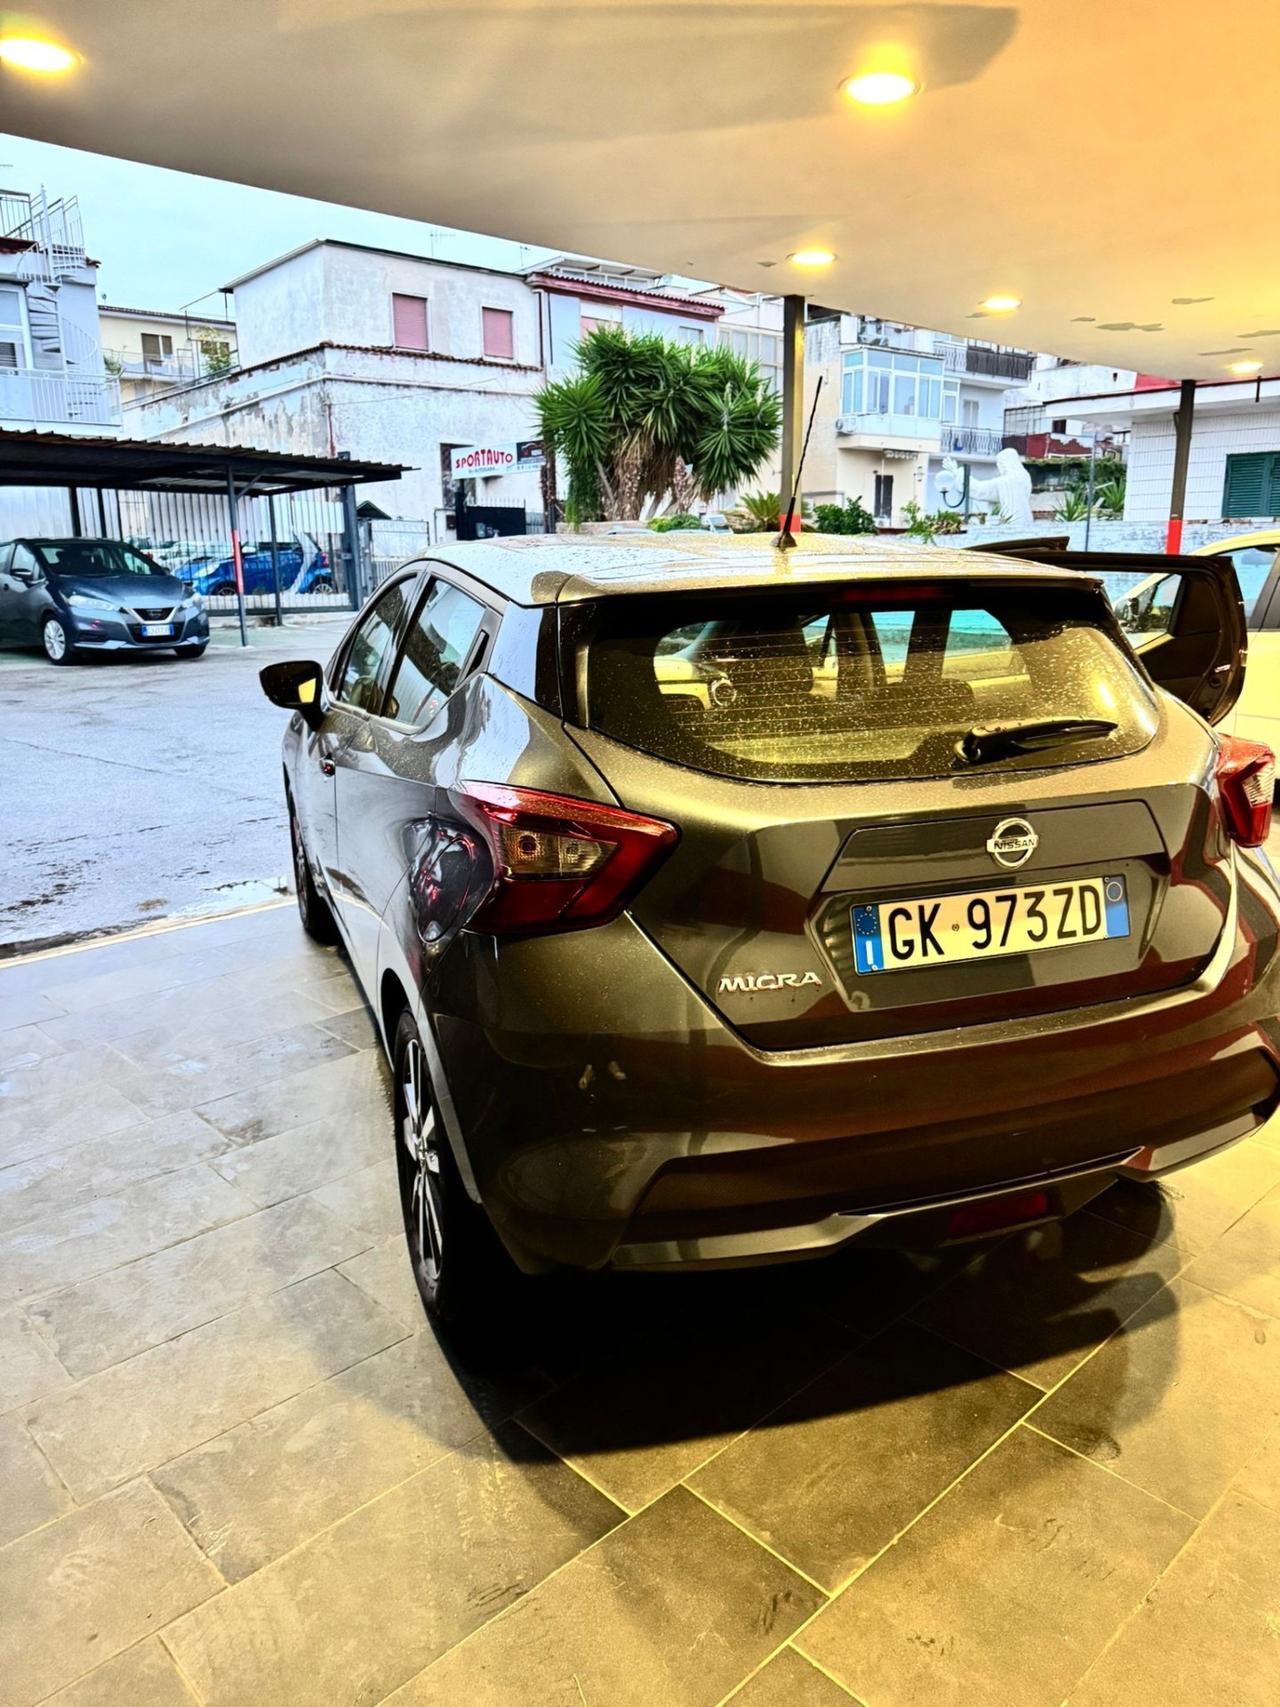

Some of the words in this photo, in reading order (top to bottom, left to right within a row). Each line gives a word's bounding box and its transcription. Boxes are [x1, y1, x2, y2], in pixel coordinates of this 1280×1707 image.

[455, 448, 513, 469] SPORTAUTO
[993, 838, 1035, 850] NISSAN
[888, 903, 945, 960] GK
[967, 884, 1102, 950] 973ZD
[719, 972, 822, 993] MICRA
